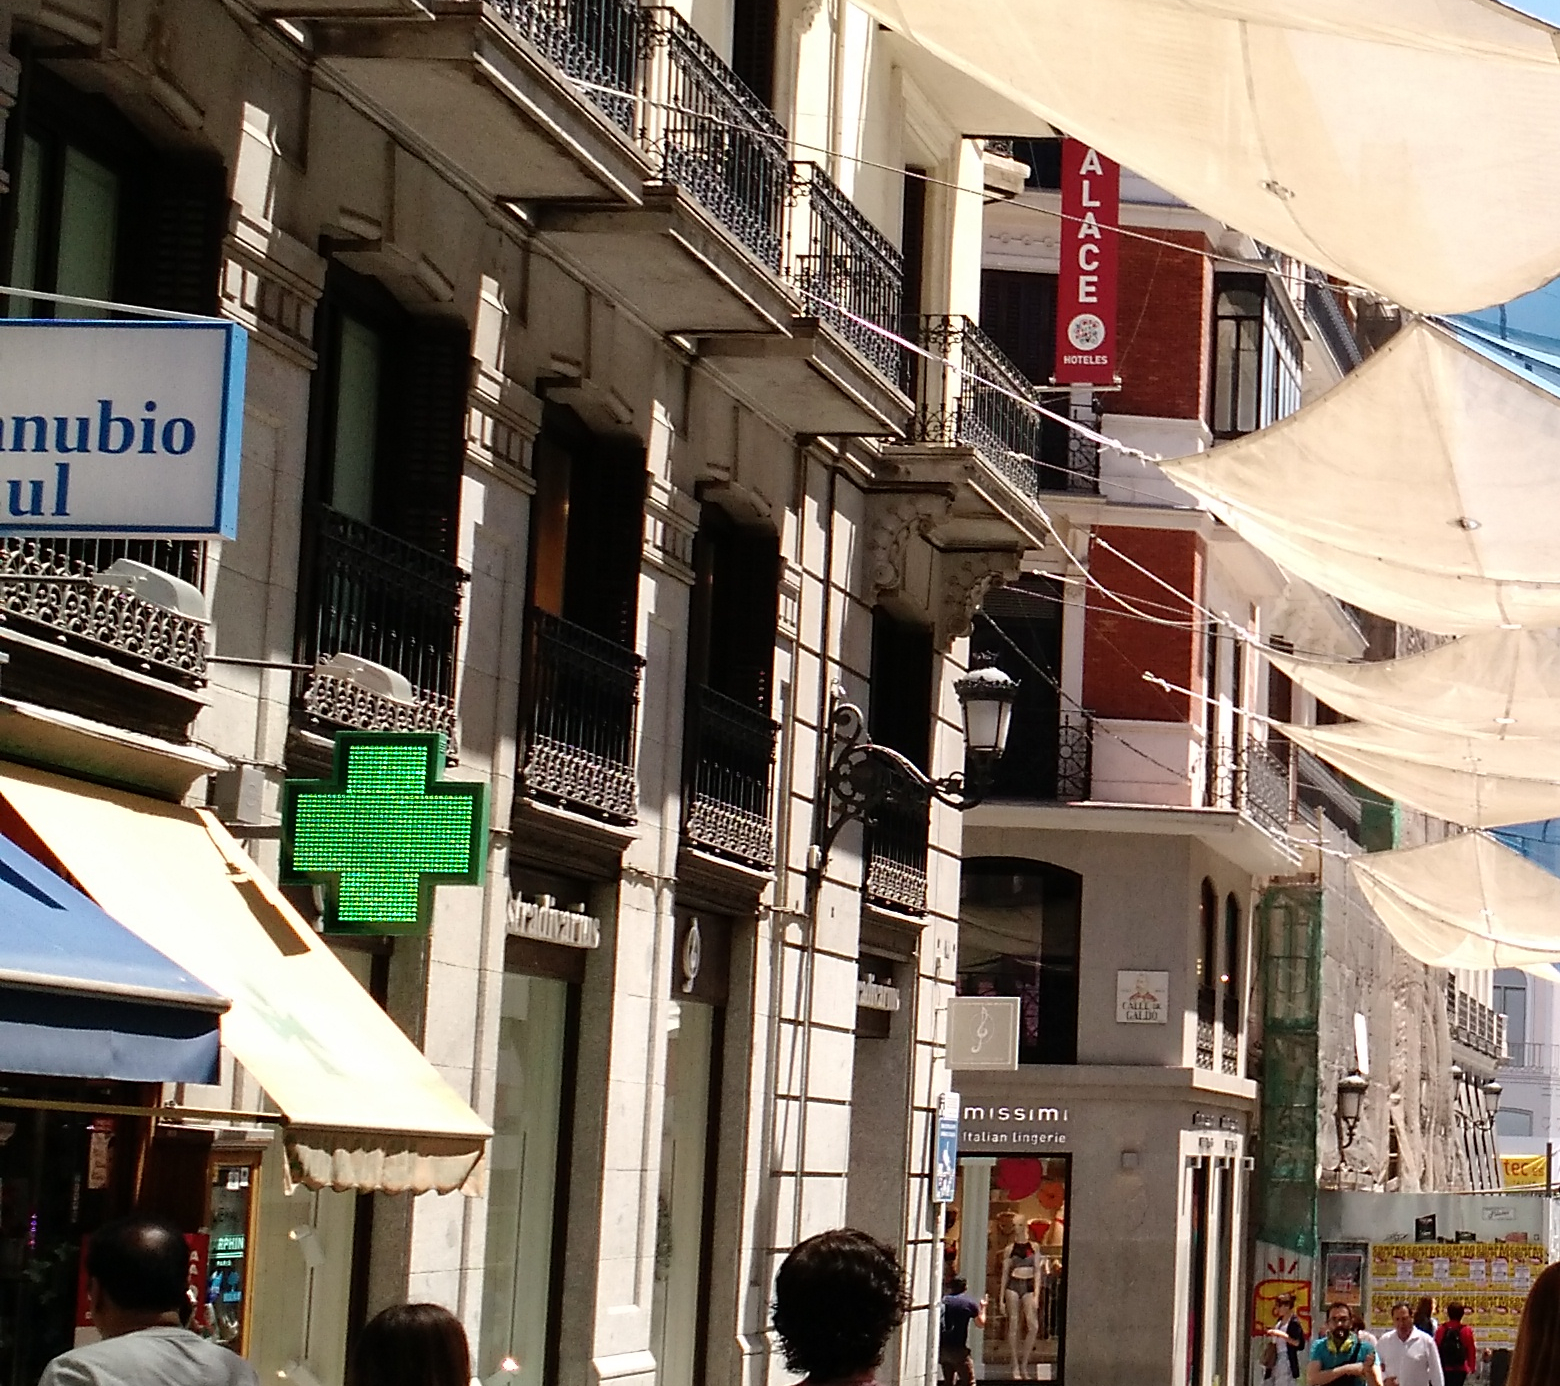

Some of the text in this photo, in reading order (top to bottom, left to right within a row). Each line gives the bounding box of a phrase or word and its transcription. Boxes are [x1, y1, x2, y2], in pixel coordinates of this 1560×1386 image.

[1077, 149, 1103, 304] ALACE
[1063, 354, 1108, 366] HOTELES
[0, 399, 196, 456] nubio
[0, 462, 71, 517] ul
[1122, 1001, 1150, 1010] CALLE
[963, 1106, 1068, 1122] missimi
[963, 1131, 1066, 1145] Italian lingerie
[211, 1237, 245, 1250] RPHIN
